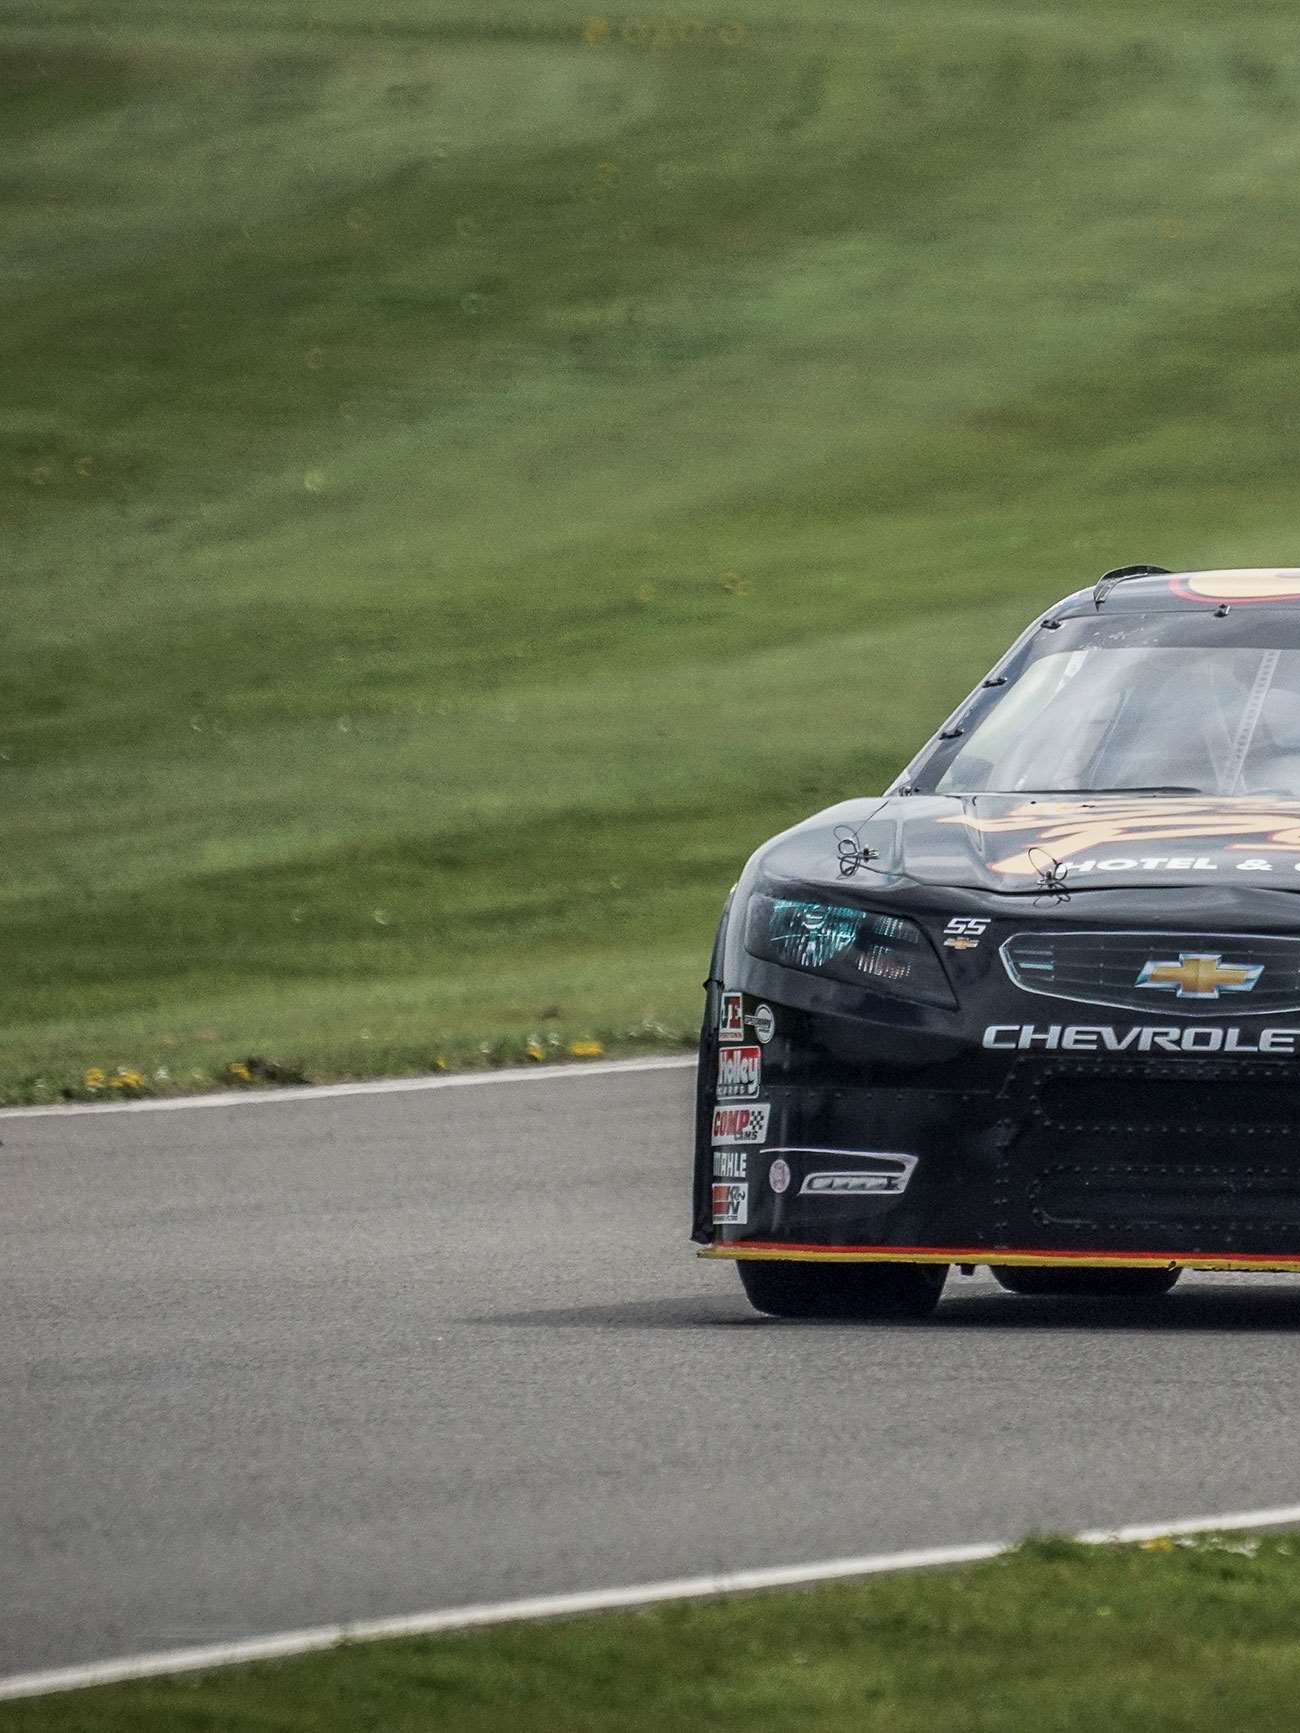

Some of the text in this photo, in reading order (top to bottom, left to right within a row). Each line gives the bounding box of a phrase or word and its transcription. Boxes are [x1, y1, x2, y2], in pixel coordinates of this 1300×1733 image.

[1055, 857, 1218, 874] HOTEL
[1235, 859, 1273, 871] &
[943, 918, 992, 935] SS
[718, 1049, 760, 1094] Holley
[714, 1110, 750, 1136] COMP
[713, 1151, 747, 1178] MAHLE
